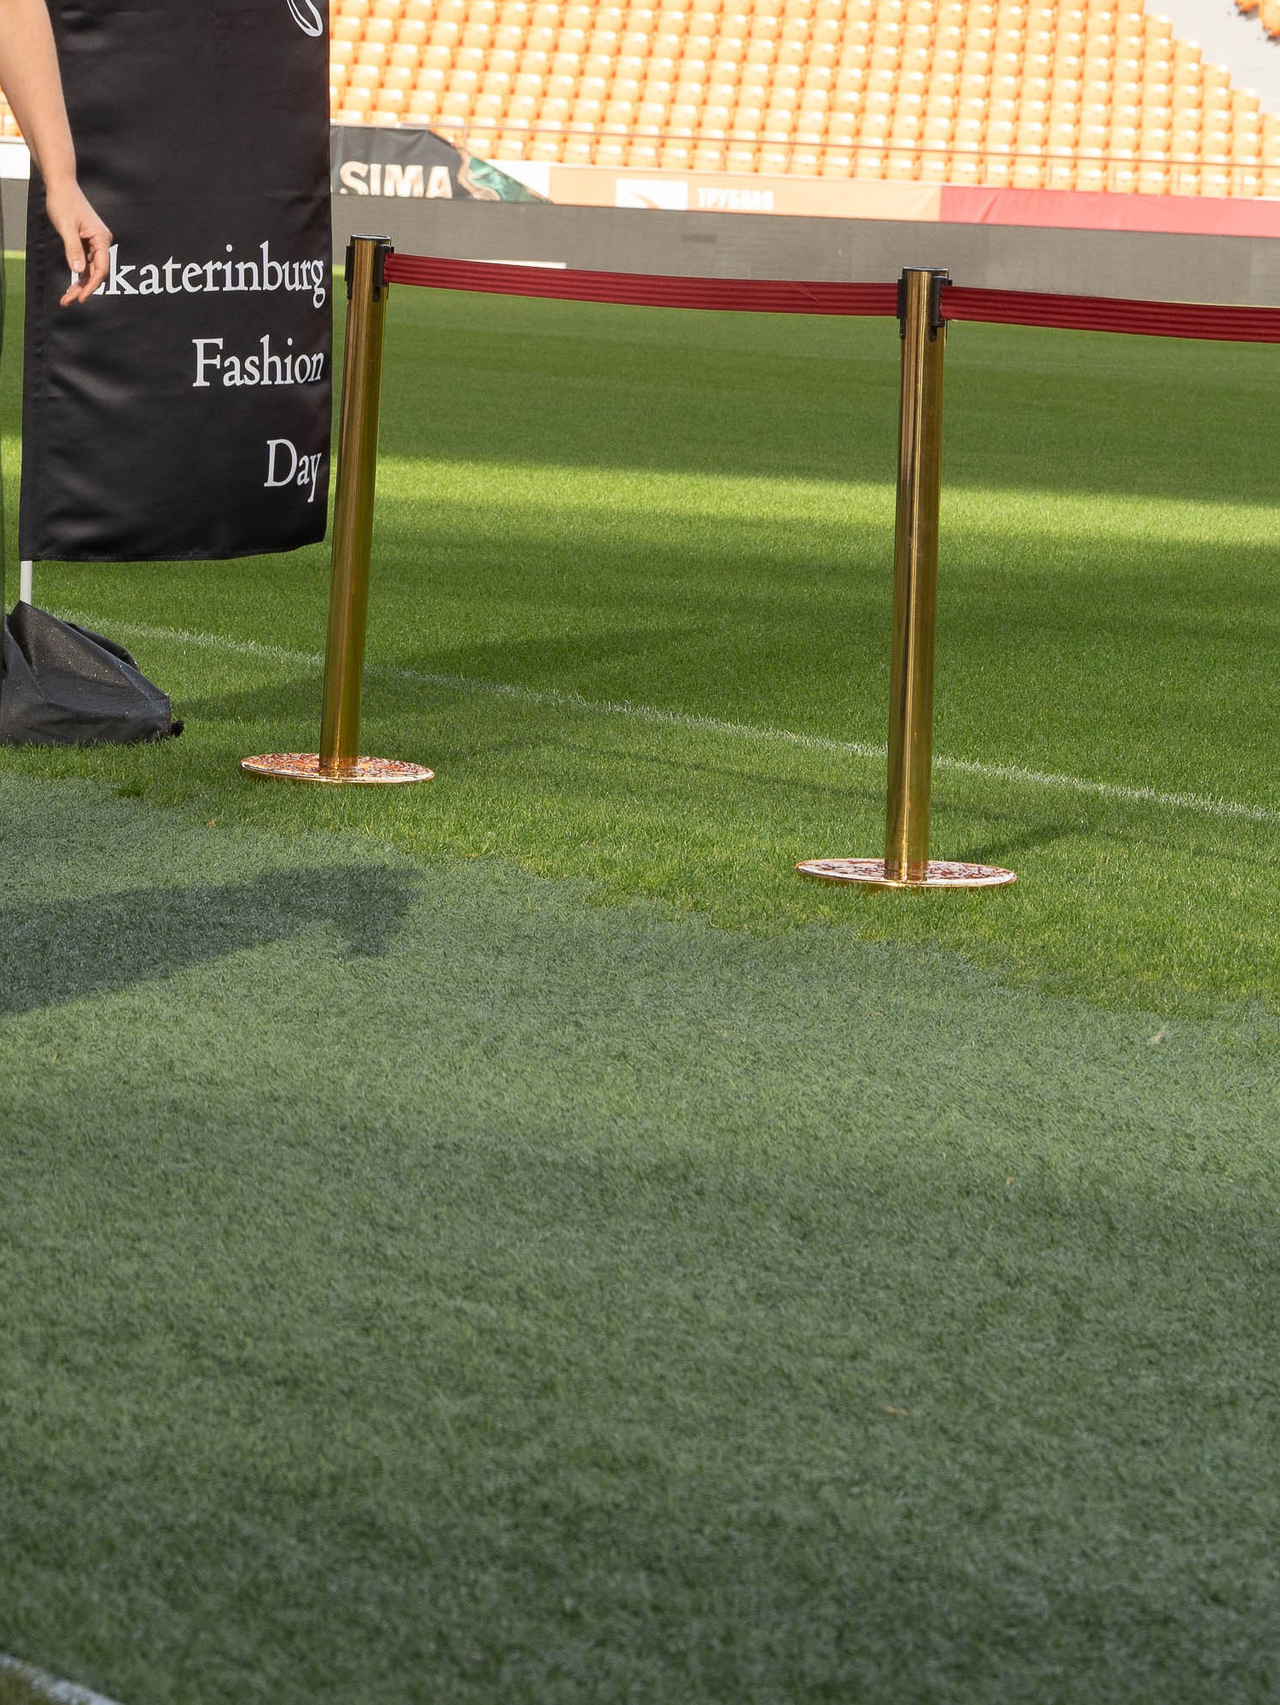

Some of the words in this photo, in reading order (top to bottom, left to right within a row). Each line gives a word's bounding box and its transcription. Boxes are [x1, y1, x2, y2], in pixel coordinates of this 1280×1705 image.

[338, 161, 453, 199] SIMA
[192, 334, 324, 387] Fashion
[263, 438, 322, 503] Day
